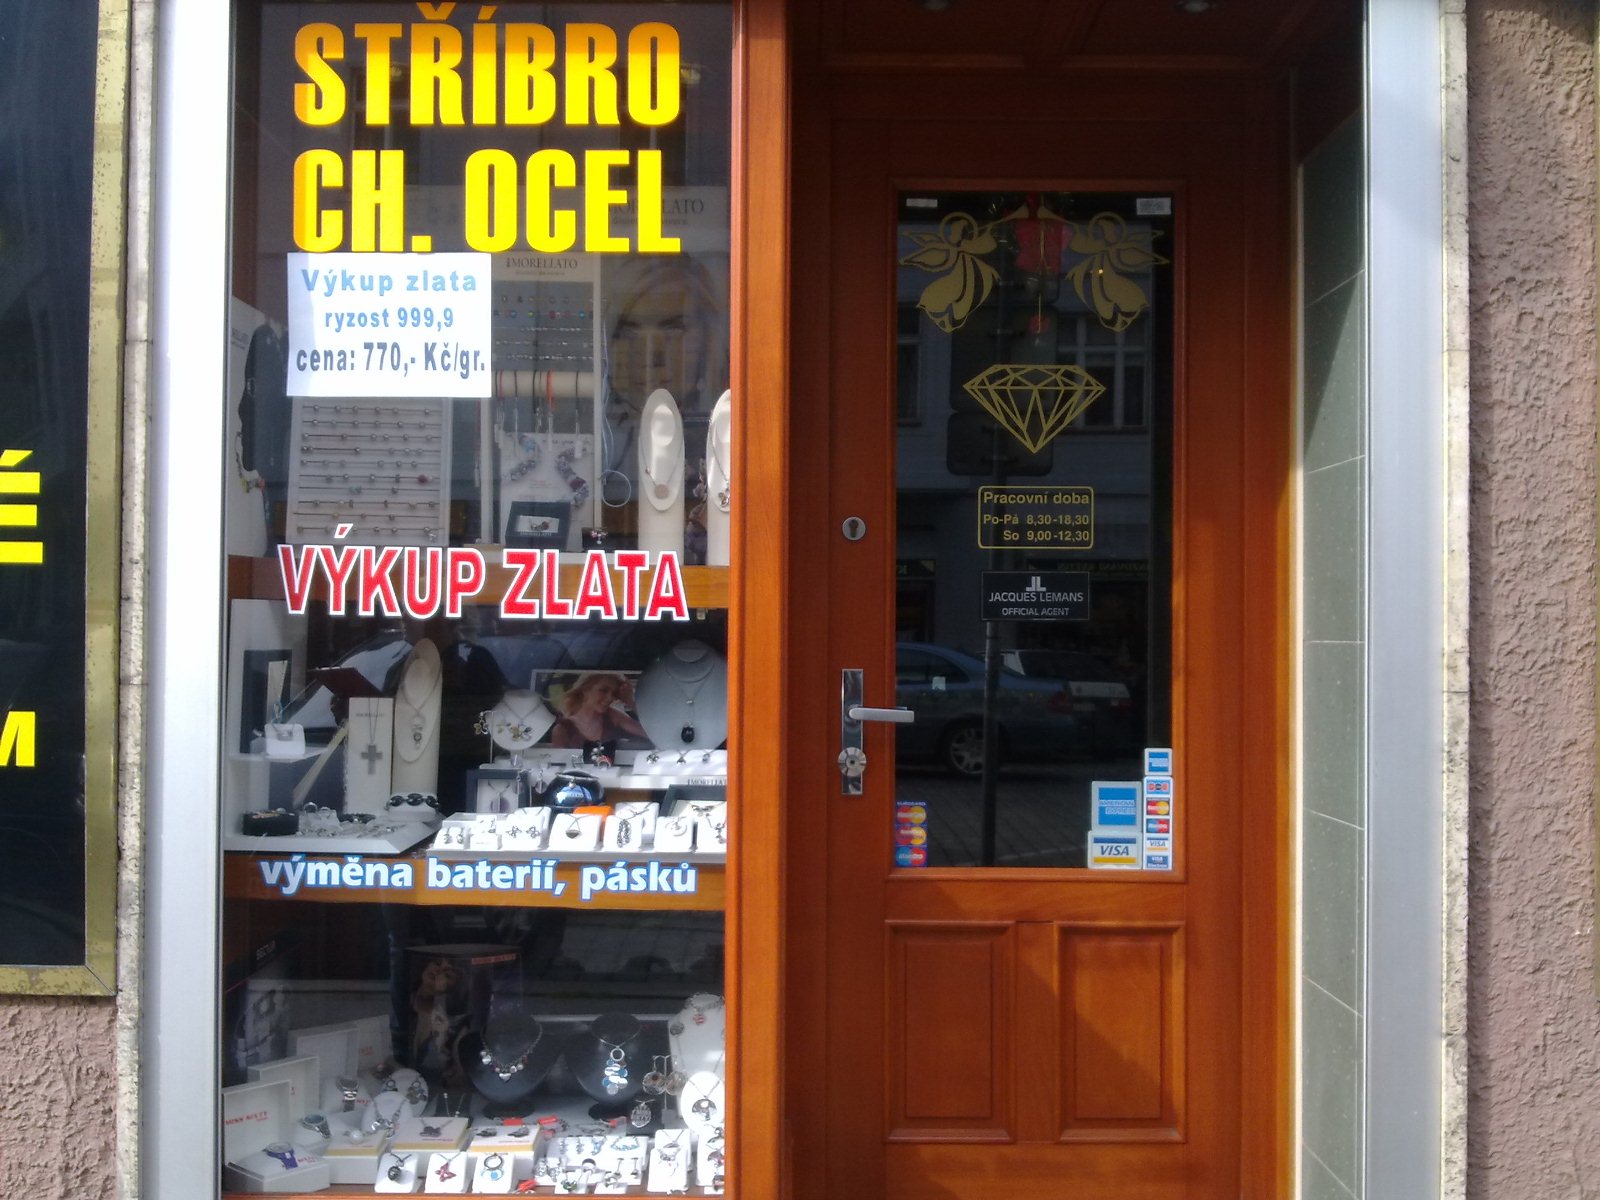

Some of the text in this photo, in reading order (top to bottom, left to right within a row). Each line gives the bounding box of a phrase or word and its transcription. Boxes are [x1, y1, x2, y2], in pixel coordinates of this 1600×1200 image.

[294, 3, 681, 127] STŘÍBRO
[293, 149, 682, 254] CH. OCEL
[300, 269, 477, 297] Výkup zlata
[325, 307, 454, 333] ryzost 999,9
[296, 342, 485, 379] cena: 770,- Kč/gr.
[983, 491, 1090, 504] Pracovní doba
[983, 513, 1019, 525] Po-Pá
[1003, 530, 1020, 541] So
[277, 523, 690, 620] VÝKUP ZLATA
[989, 592, 1084, 602] JACQUES LEMANS
[1002, 607, 1070, 616] OFFICIAL AGENT
[1100, 845, 1130, 856] VISA
[260, 852, 698, 900] výměna baterií, pásků
